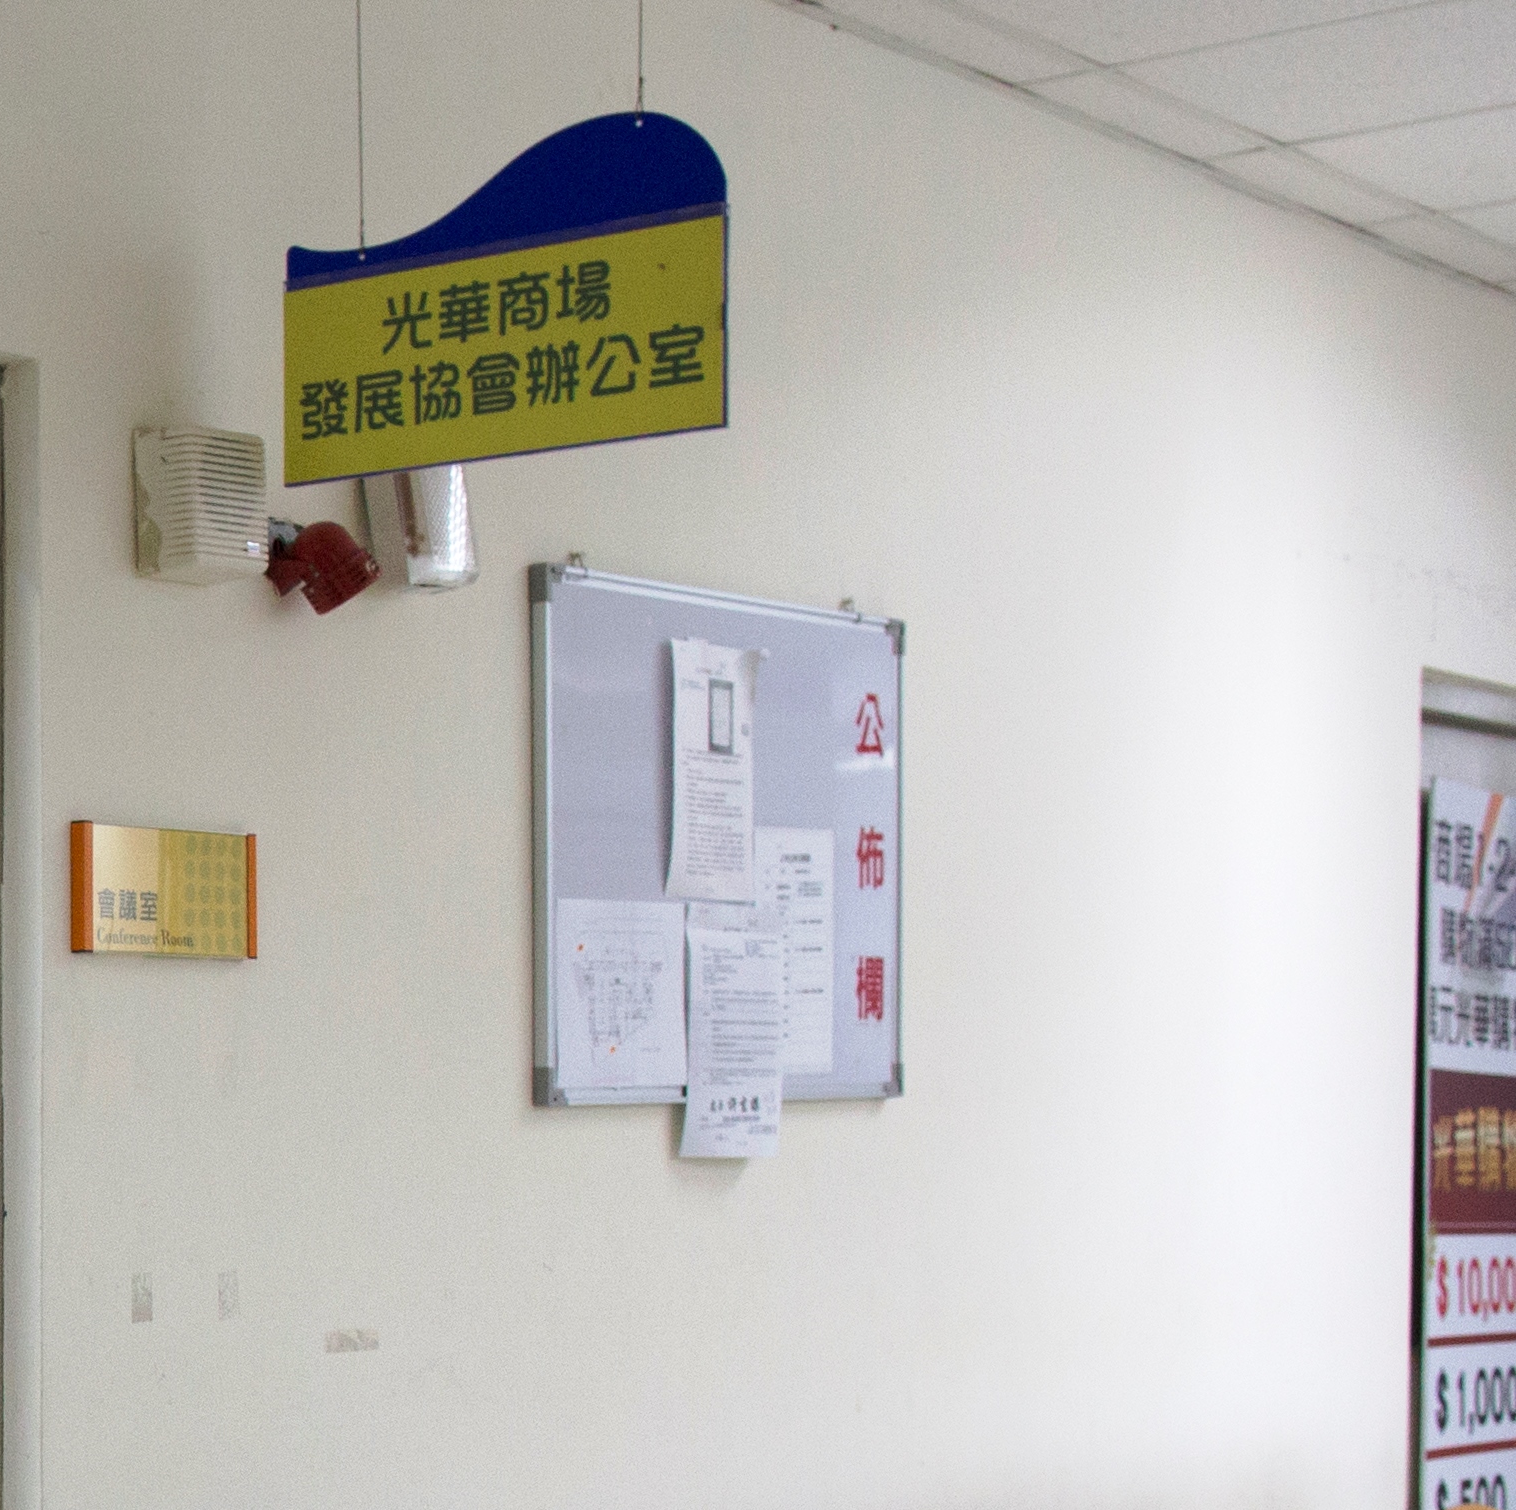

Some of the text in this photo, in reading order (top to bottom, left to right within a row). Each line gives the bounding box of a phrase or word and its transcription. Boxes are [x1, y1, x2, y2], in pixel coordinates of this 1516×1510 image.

[381, 260, 611, 355] 光華商場
[300, 324, 706, 440] 發展協會辦公室
[97, 888, 158, 921] 會議室
[97, 927, 194, 948] Conference Room
